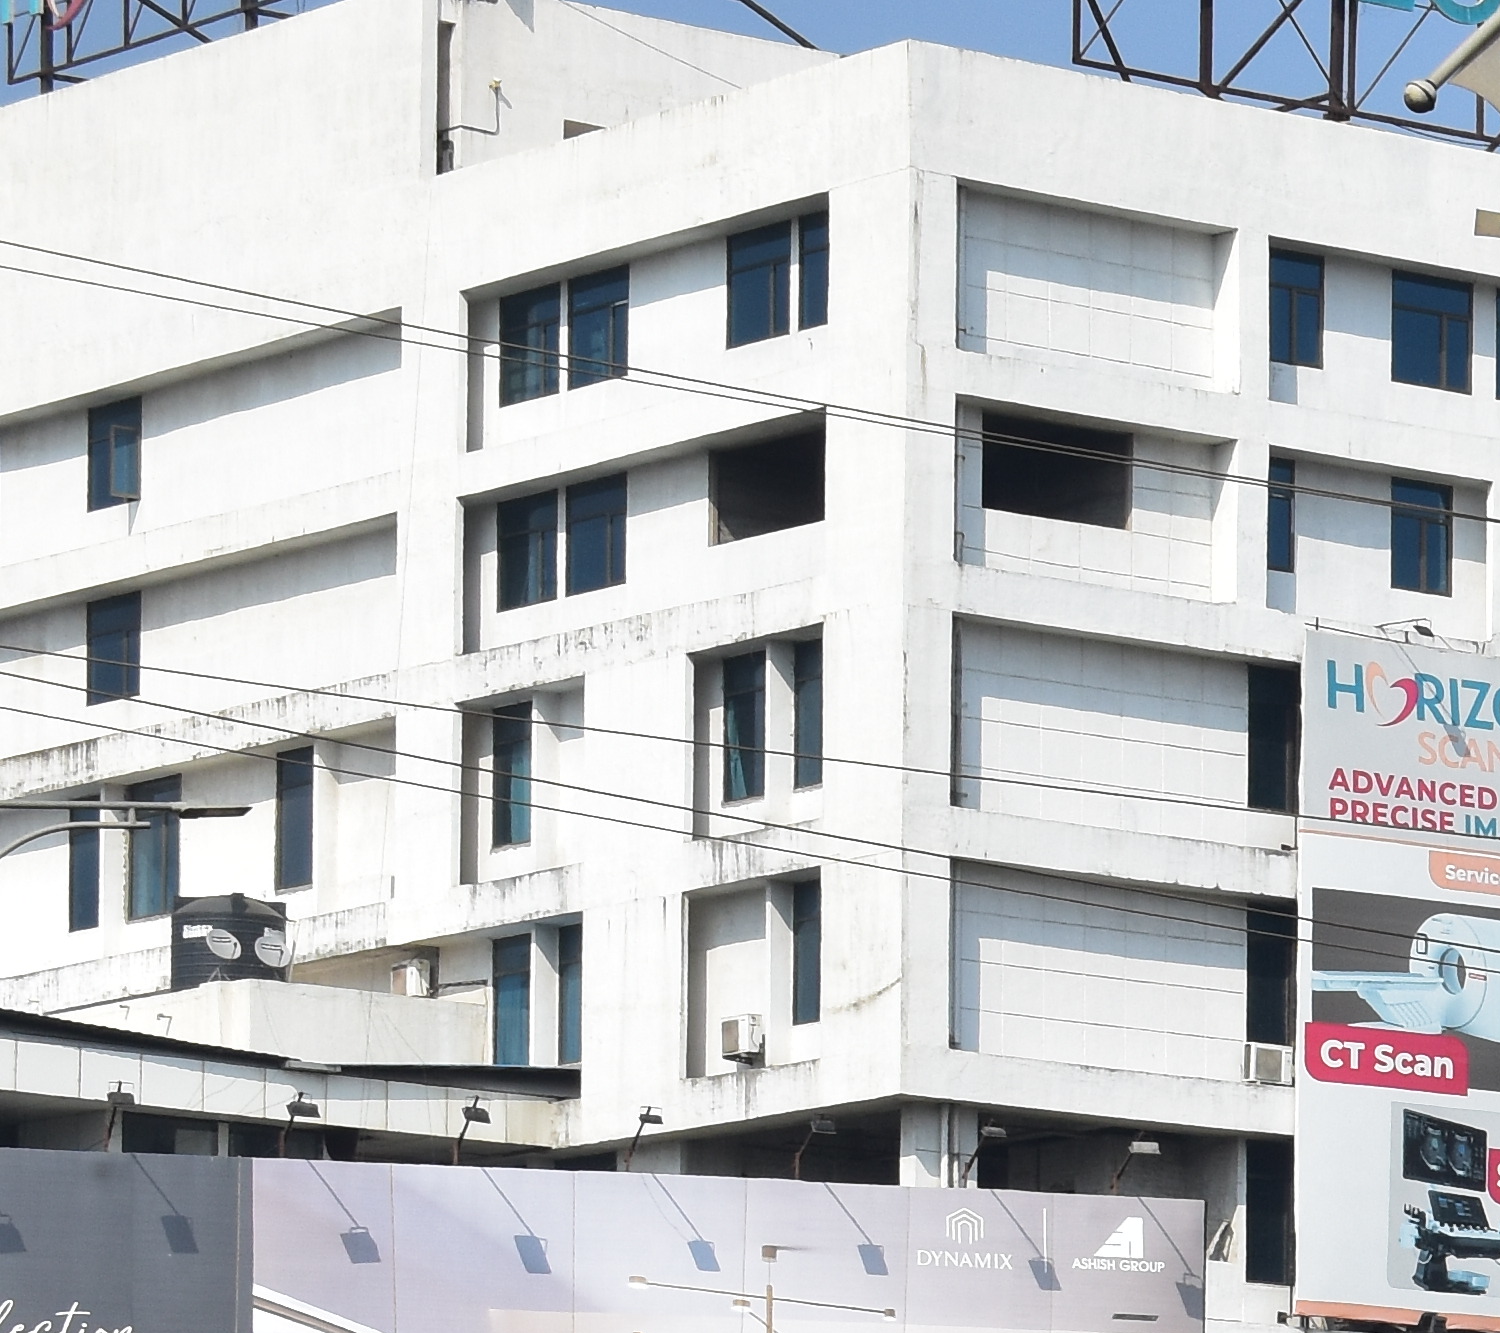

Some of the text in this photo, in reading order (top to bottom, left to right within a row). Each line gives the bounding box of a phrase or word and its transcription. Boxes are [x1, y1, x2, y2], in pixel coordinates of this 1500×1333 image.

[1329, 767, 1498, 811] ADVANCED
[1330, 797, 1455, 834] PRECISE
[1320, 1039, 1454, 1080] CT Scan
[916, 1250, 1166, 1273] DYNAMIX ASHISH GROUP
